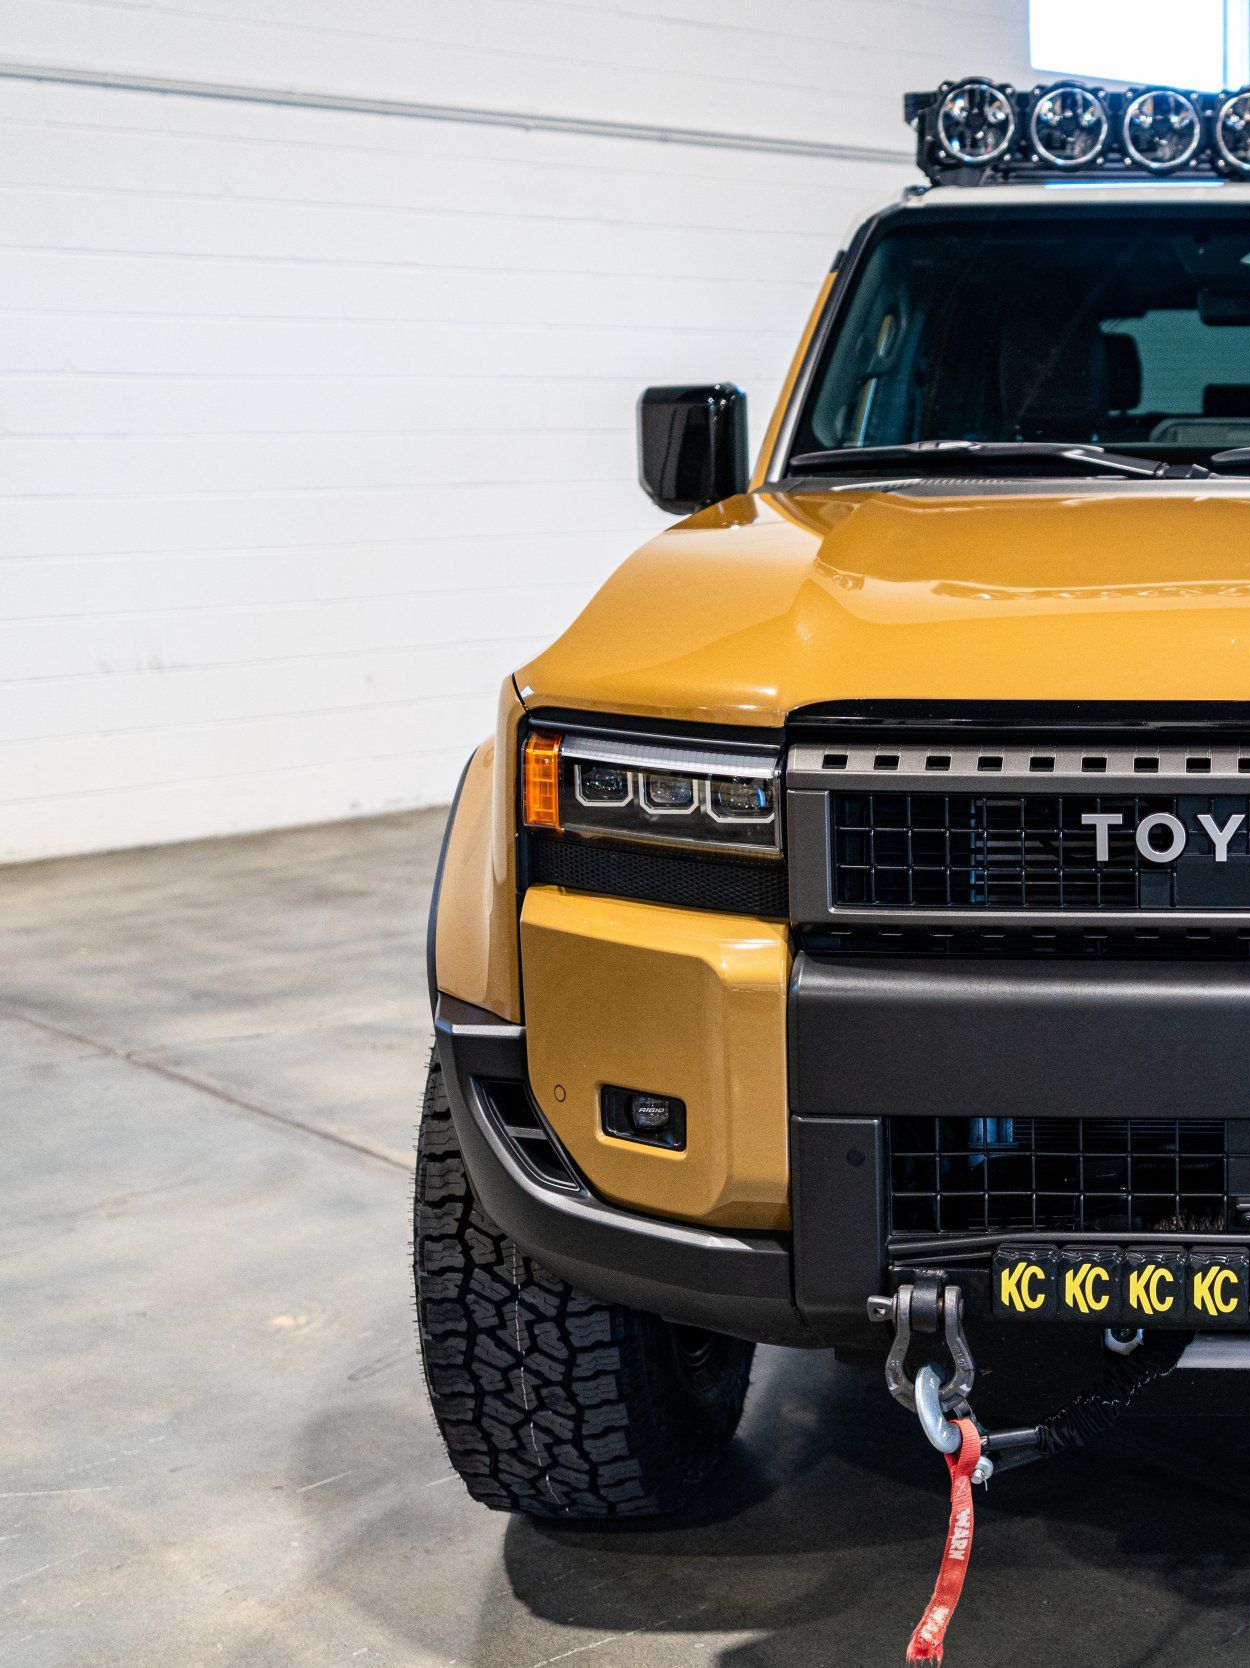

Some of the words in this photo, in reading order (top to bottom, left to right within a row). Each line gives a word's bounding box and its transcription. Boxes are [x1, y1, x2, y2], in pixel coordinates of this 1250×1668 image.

[1001, 1262, 1045, 1312] KC
[1065, 1264, 1109, 1313] KC
[1130, 1265, 1173, 1314] KC
[1194, 1266, 1238, 1316] KC
[948, 1507, 971, 1561] WARN
[919, 1605, 950, 1645] WA
